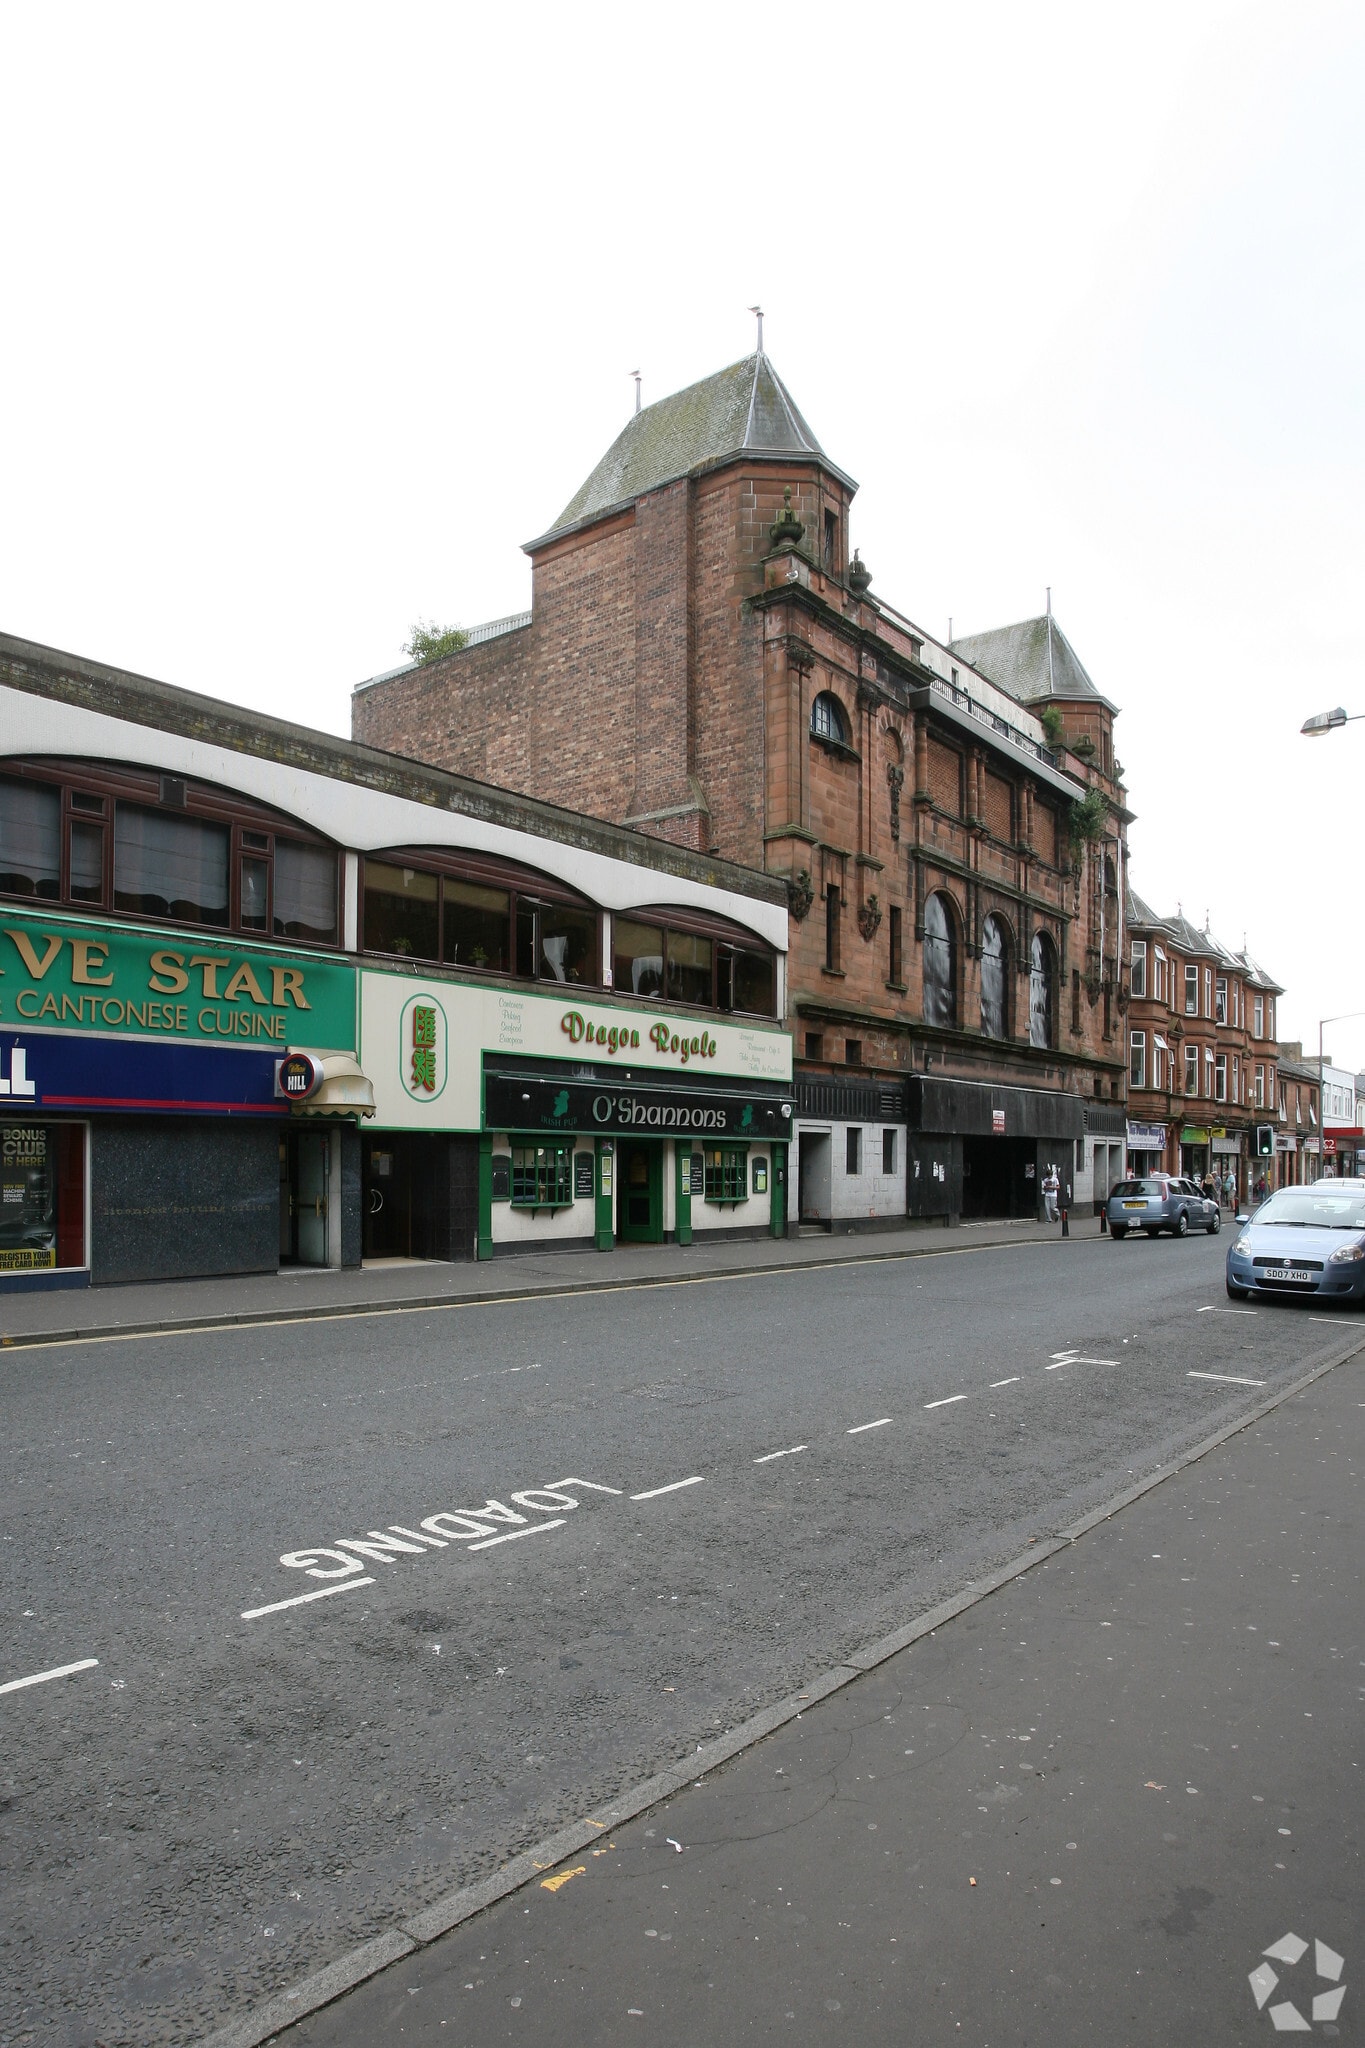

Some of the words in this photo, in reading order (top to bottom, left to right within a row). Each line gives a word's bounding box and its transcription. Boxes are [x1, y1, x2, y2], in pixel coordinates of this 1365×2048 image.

[0, 929, 114, 986] VE
[148, 950, 312, 1010] STAR
[498, 997, 524, 1010] Cantonese
[16, 989, 188, 1031] CANTONESE
[197, 1007, 287, 1039] CUISINE
[500, 1021, 522, 1034] Seafood
[499, 1034, 524, 1046] European
[561, 1011, 640, 1054] Dragon
[650, 1022, 717, 1063] Royale
[287, 1075, 306, 1091] HILL
[592, 1095, 726, 1128] O'Shannons
[540, 1114, 561, 1127] IRISH
[563, 1116, 577, 1127] PUB
[3, 1129, 47, 1140] BONUS
[2, 1141, 46, 1156] CLUB
[3, 1156, 13, 1167] IS
[16, 1156, 46, 1167] HERE!
[173, 1204, 225, 1214] betting
[0, 1252, 32, 1261] REGISTER
[33, 1251, 51, 1260] YOUR
[0, 1261, 14, 1269] FREE
[15, 1260, 32, 1268] CARD
[34, 1260, 51, 1268] NOW!
[1266, 1269, 1288, 1279] SD07
[1291, 1271, 1308, 1280] XHO
[280, 1478, 622, 1578] LOADING
